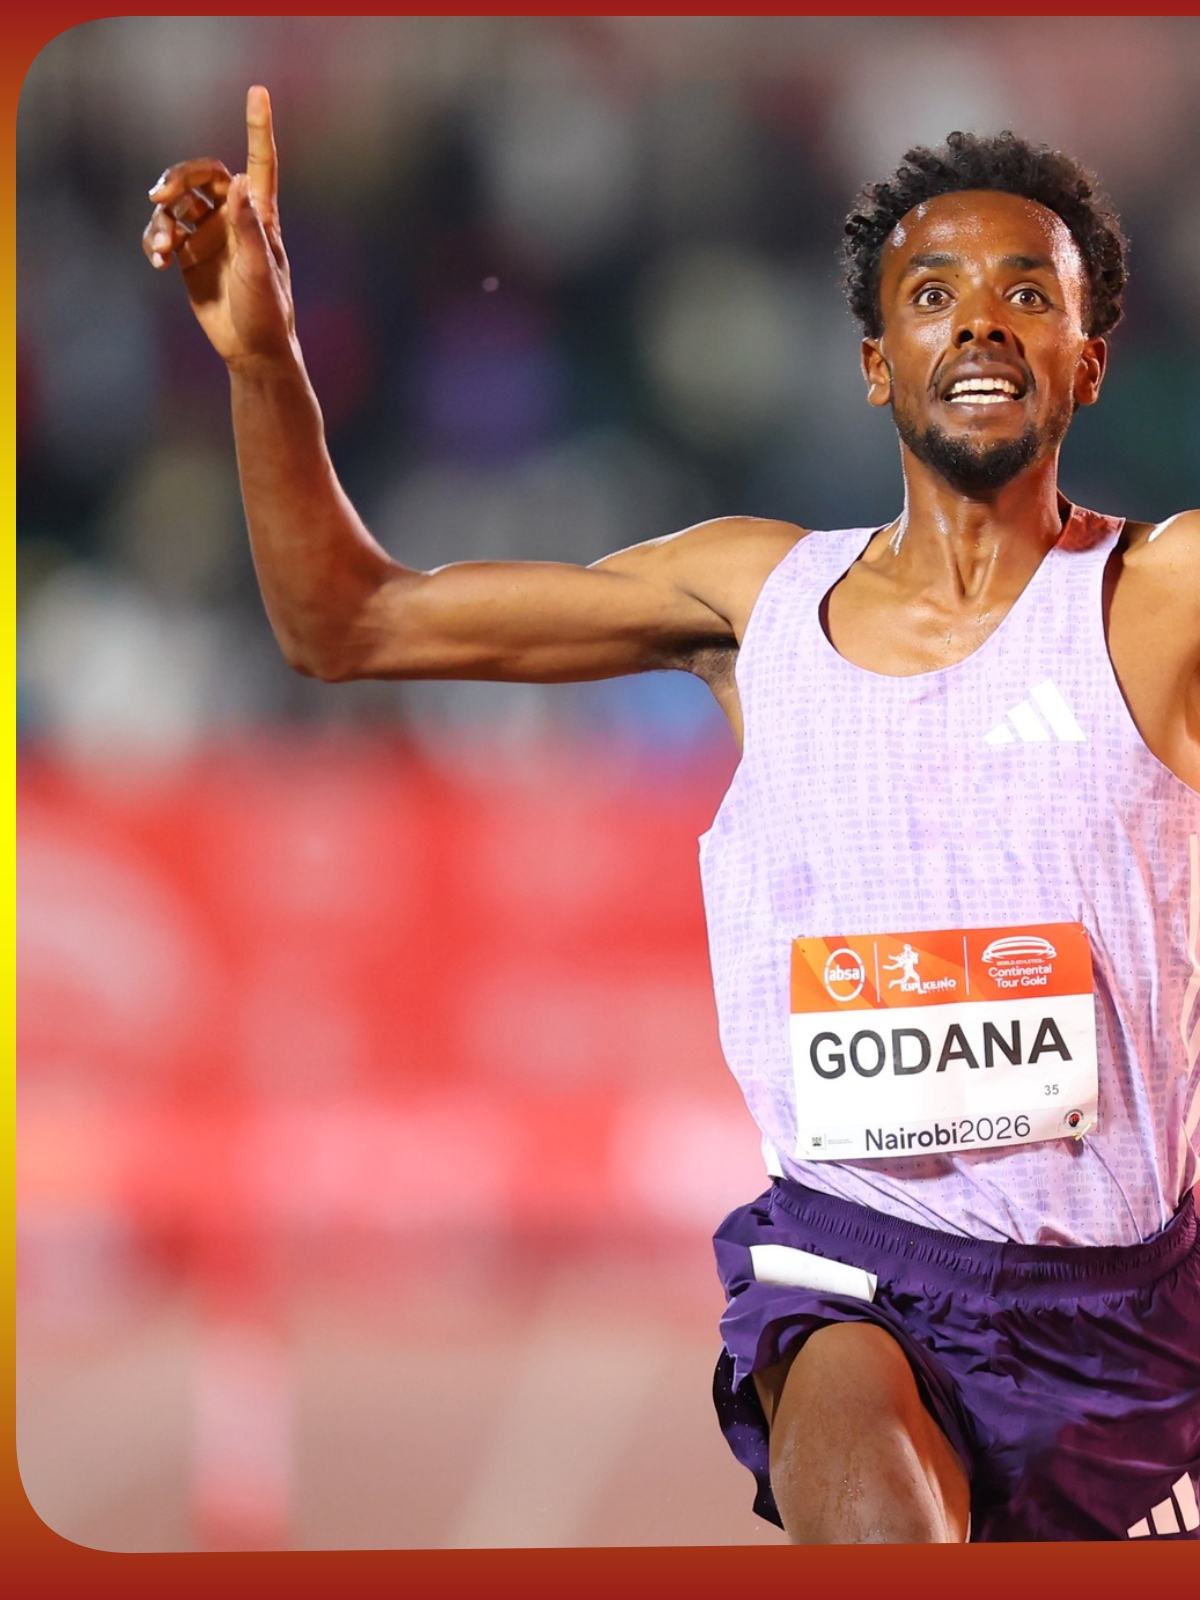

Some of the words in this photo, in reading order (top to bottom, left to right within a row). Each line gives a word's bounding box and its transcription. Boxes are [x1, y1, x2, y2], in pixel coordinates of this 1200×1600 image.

[829, 964, 860, 981] absa
[988, 964, 1052, 978] Continental
[995, 977, 1019, 989] Tour
[1020, 975, 1047, 987] Gold
[809, 1017, 1073, 1080] GODANA
[1044, 1084, 1060, 1096] 35
[865, 1114, 1031, 1151] Nairobi2026
